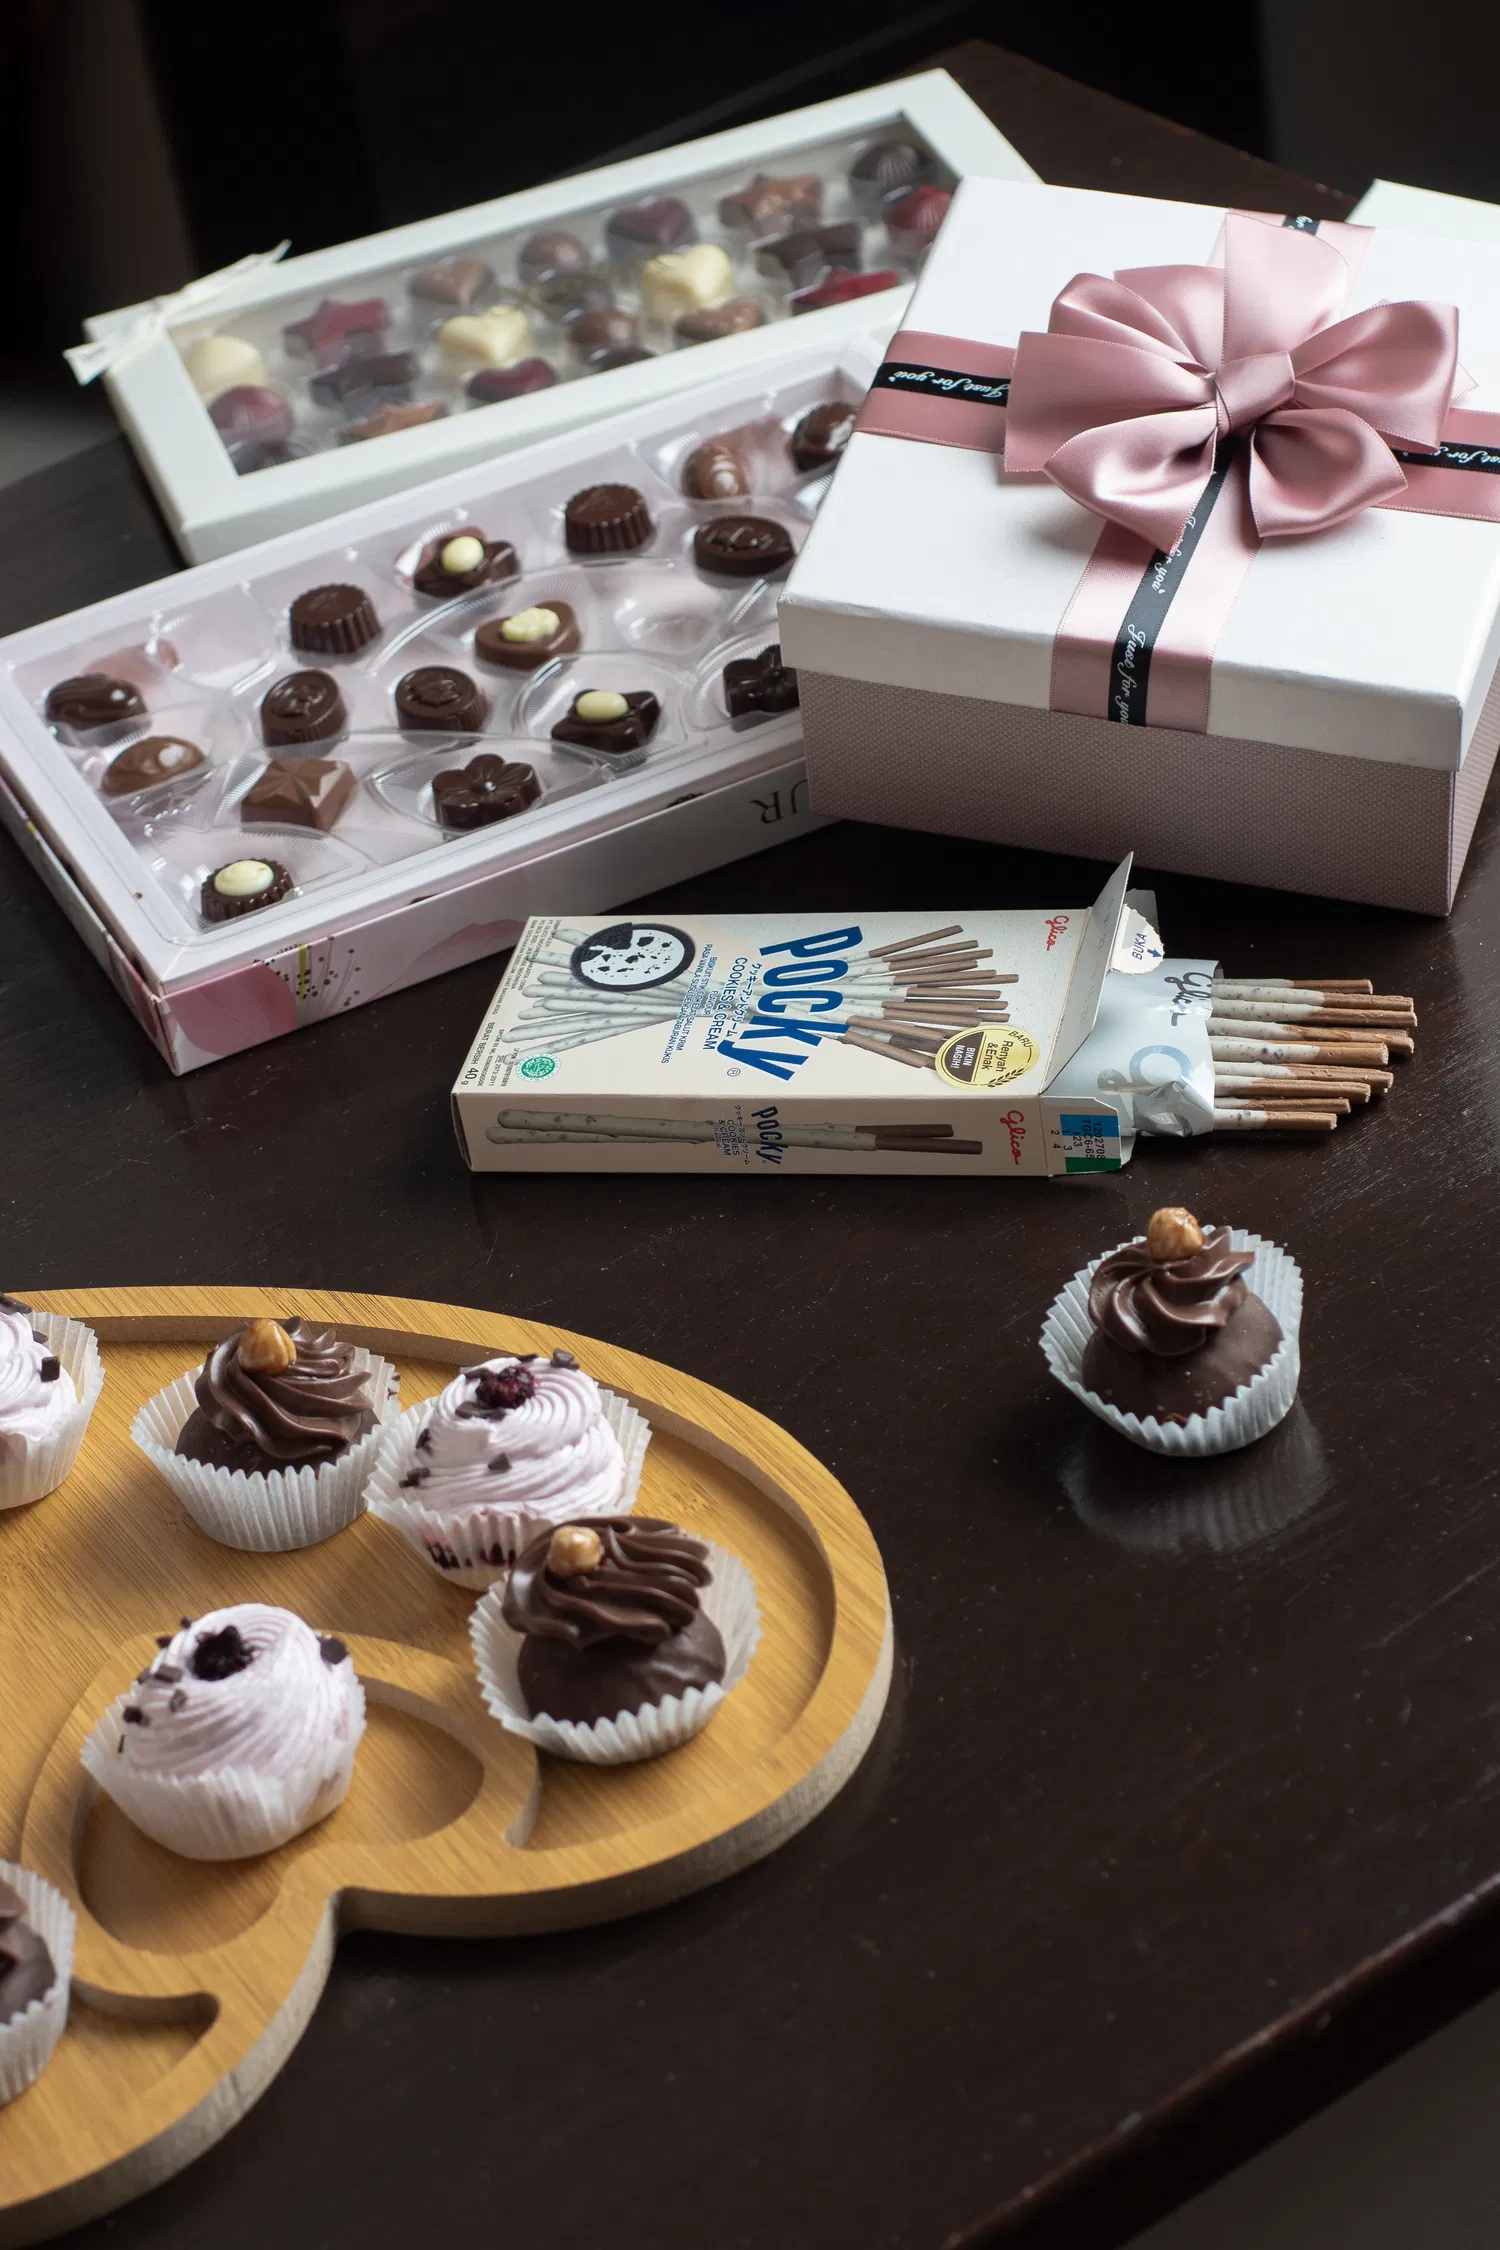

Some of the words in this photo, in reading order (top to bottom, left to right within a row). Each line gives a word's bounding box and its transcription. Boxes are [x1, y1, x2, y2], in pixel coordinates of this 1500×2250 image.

[931, 378, 972, 391] for
[1151, 562, 1168, 591] you
[1127, 623, 1147, 669] Just
[1117, 661, 1138, 698] for
[1045, 915, 1069, 951] Glico
[1131, 932, 1148, 960] BUKA
[721, 957, 748, 1001] COOKIES
[716, 1003, 731, 1012] &
[702, 1012, 728, 1050] CREAM
[1008, 1030, 1034, 1048] BARU
[470, 1042, 487, 1065] BERSIH
[963, 1047, 976, 1066] BIKIN
[996, 1040, 1014, 1072] Renyah
[465, 1067, 479, 1080] 40
[719, 1126, 732, 1156] CREAM
[727, 1119, 740, 1156] COOKIES
[1000, 1110, 1026, 1165] Glico
